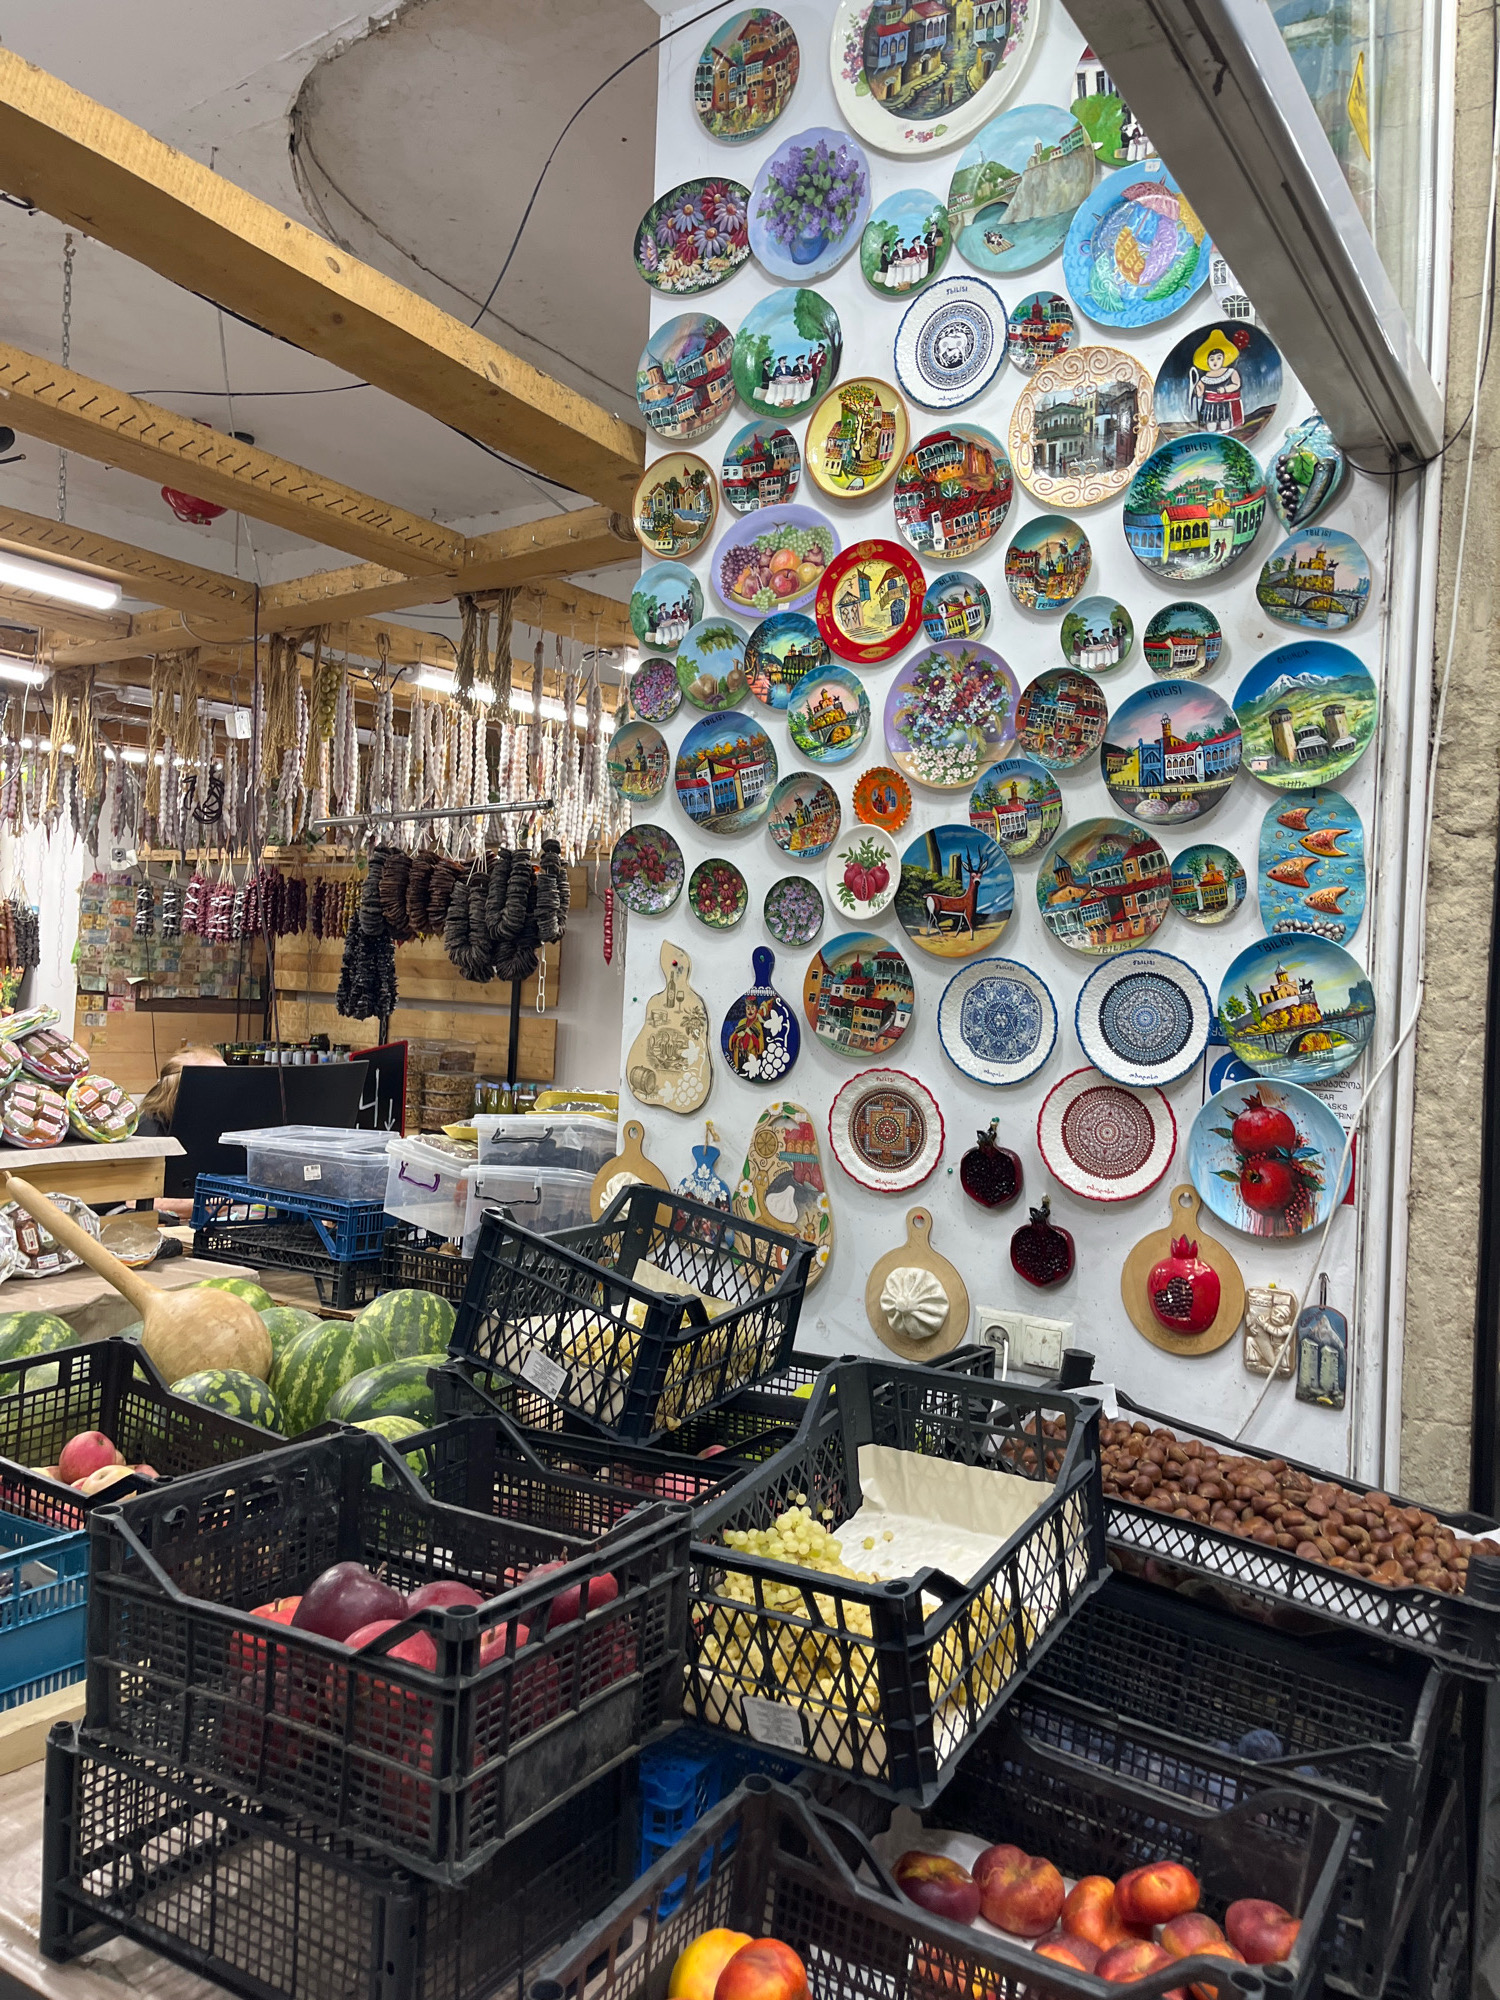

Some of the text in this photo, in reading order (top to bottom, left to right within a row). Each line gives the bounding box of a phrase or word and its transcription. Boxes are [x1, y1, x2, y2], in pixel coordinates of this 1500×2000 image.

[1177, 442, 1213, 454] TBILISI
[1305, 528, 1332, 538] TBILISI
[940, 544, 975, 558] TBILISI
[935, 574, 960, 587] TBILISI
[1172, 605, 1198, 613] TBILISI
[1276, 649, 1311, 664] GEORGIA
[1146, 686, 1183, 700] TBILISI
[701, 715, 726, 728] TBILISI
[993, 760, 1021, 775] TBILISI
[779, 772, 810, 788] GEORGIA
[1097, 943, 1133, 954] TBILISI
[1255, 936, 1296, 953] TBILISI
[1315, 1093, 1335, 1101] EAR
